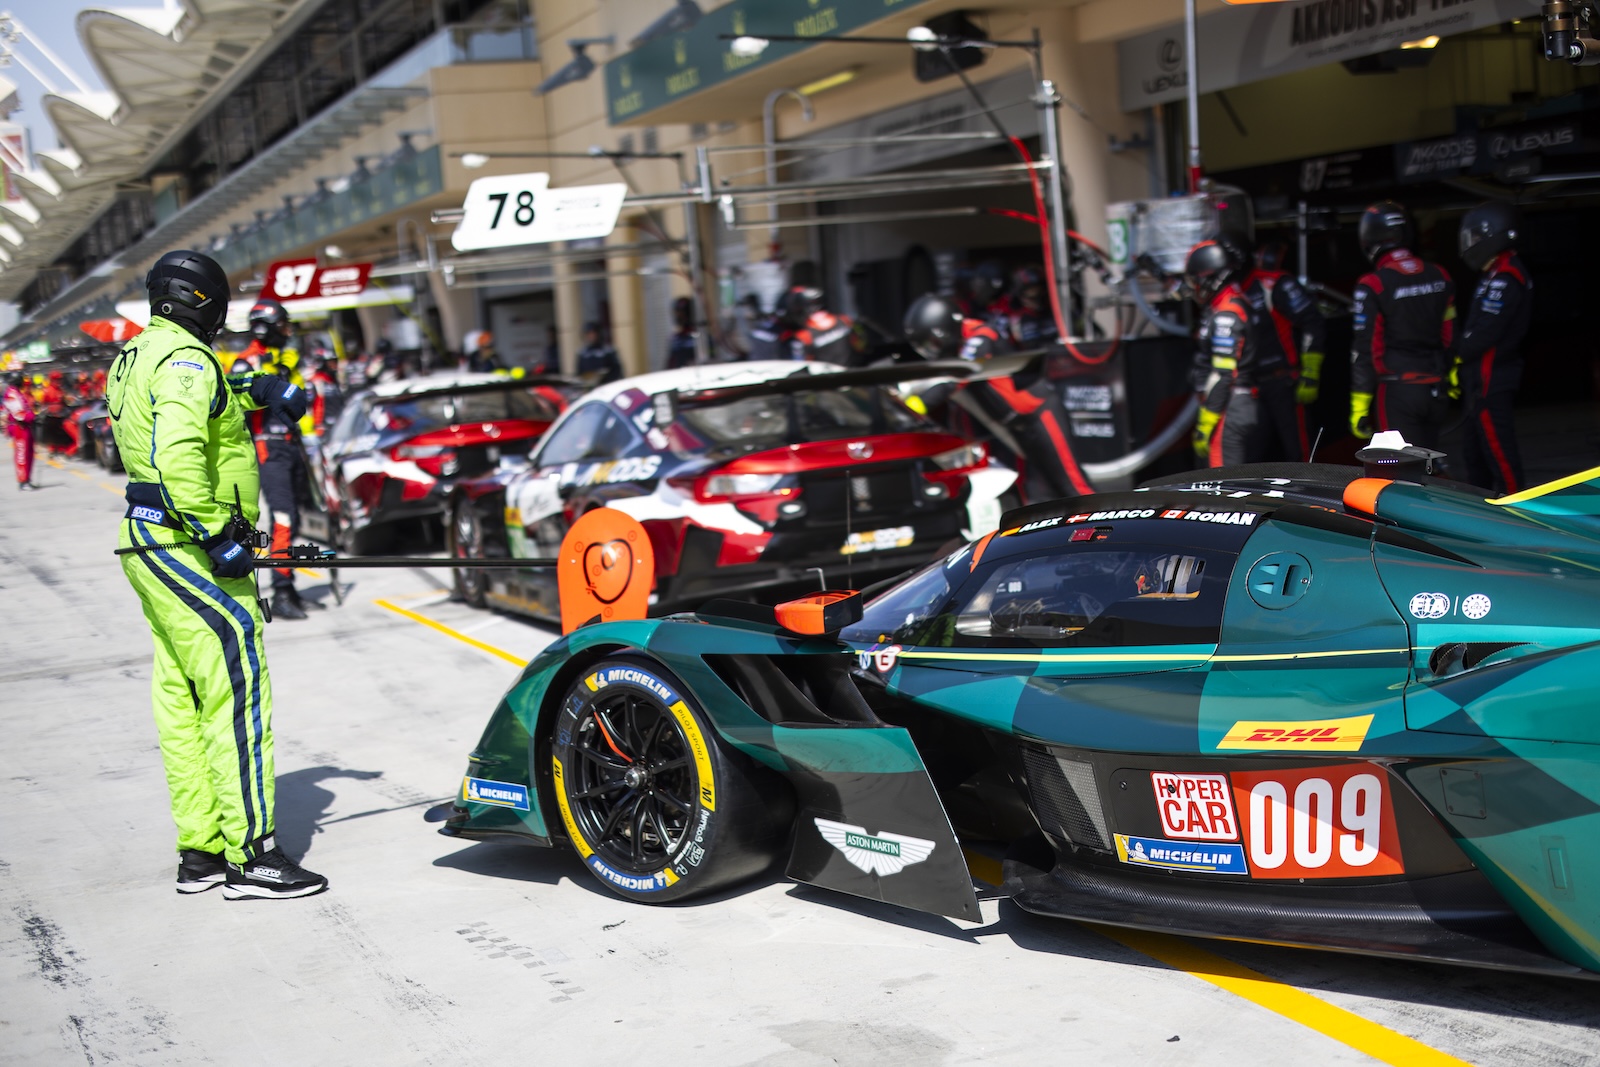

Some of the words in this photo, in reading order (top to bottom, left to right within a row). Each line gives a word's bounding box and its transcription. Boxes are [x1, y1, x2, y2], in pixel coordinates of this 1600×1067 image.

[1512, 128, 1575, 152] LEXUS
[488, 190, 535, 230] 78
[275, 264, 317, 297] 87
[131, 506, 163, 520] sparco
[1018, 516, 1063, 533] ALEX
[1087, 509, 1155, 522] MARCO
[1183, 511, 1256, 526] ROMAN
[1411, 597, 1448, 614] FIA
[608, 669, 671, 700] MICHELIN
[678, 708, 693, 731] PILOT
[690, 732, 705, 761] SPORT
[1245, 726, 1341, 743] DHL
[553, 764, 562, 780] M
[479, 787, 523, 803] MICHELIN
[701, 786, 713, 804] M
[1156, 777, 1225, 801] HYPER
[1163, 799, 1233, 836] CAR
[1249, 773, 1383, 870] 009
[846, 835, 871, 848] ASTON
[871, 841, 899, 855] MARTIN
[1150, 848, 1232, 865] MICHELIN
[252, 866, 282, 878] sparco
[592, 859, 655, 890] MICHELIN
